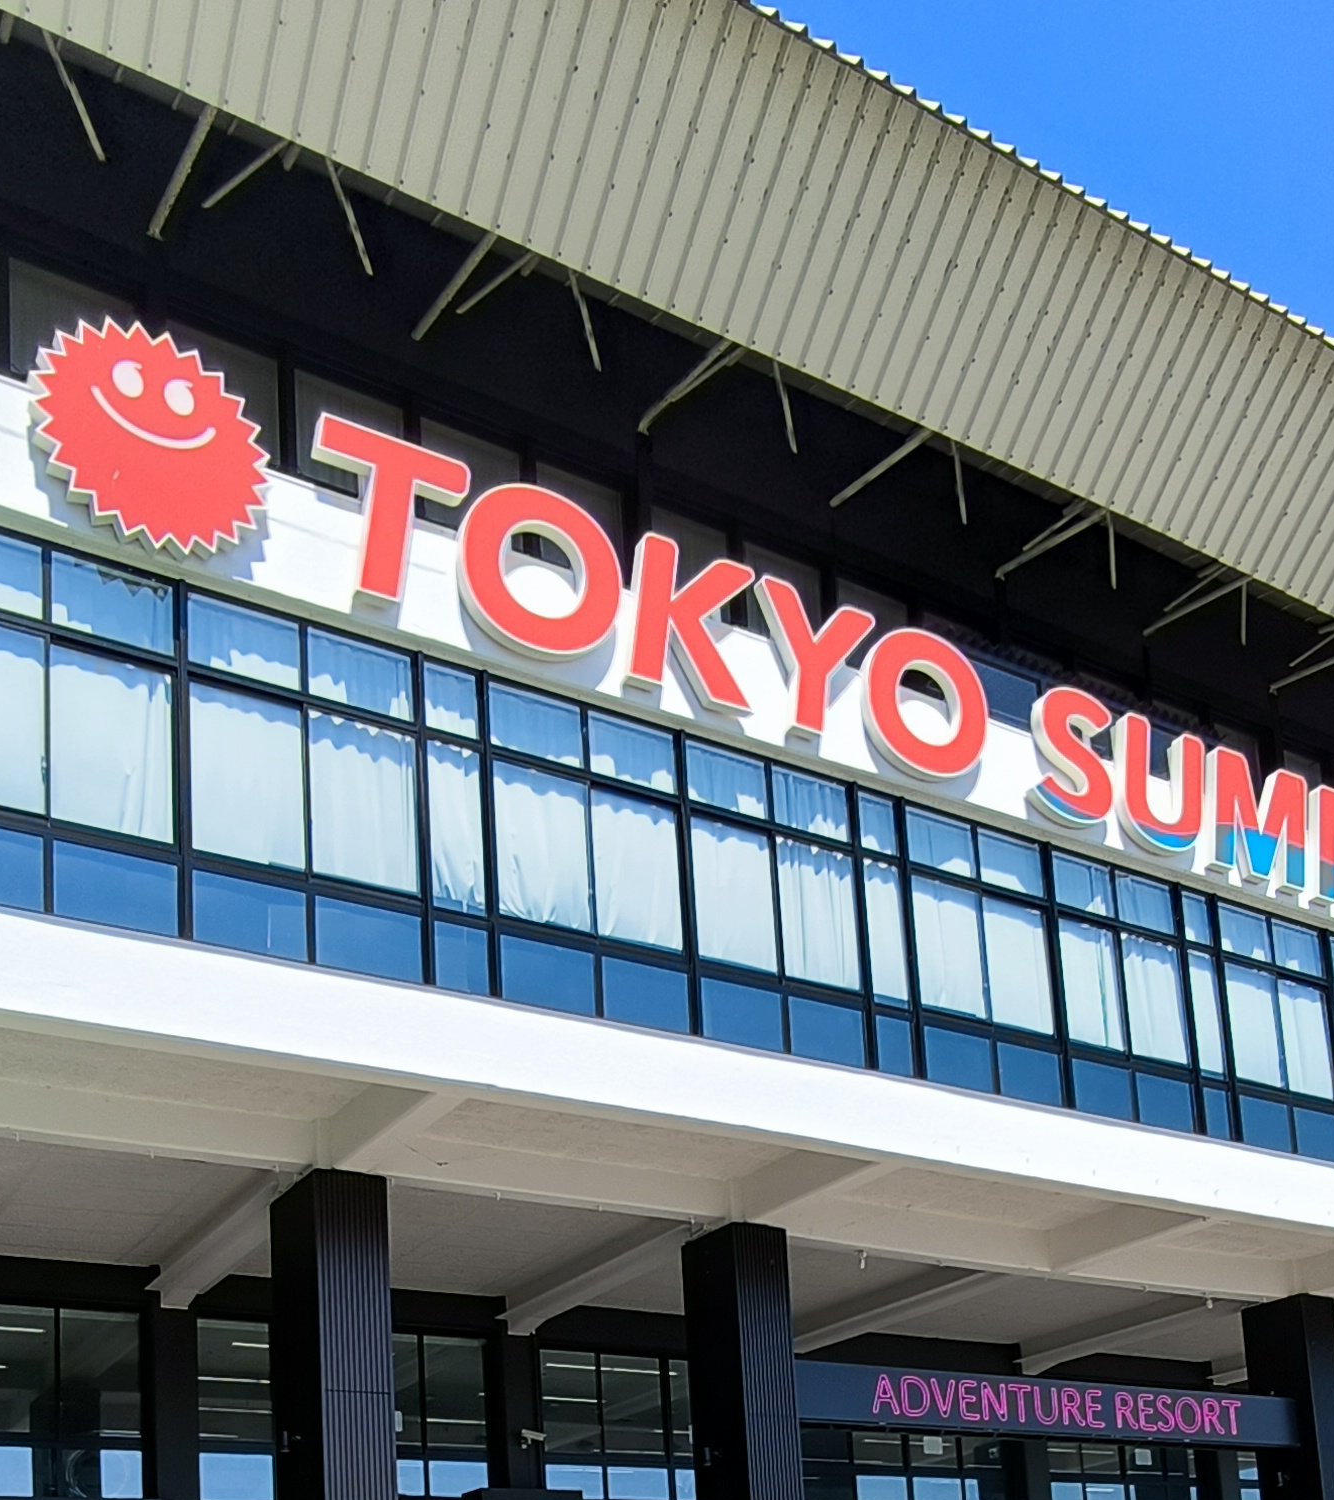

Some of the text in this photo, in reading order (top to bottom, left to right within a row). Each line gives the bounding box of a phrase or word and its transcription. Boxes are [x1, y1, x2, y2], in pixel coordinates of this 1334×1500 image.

[312, 412, 989, 782] TOKYO
[872, 1373, 1242, 1436] ADVENTURE RESORT
